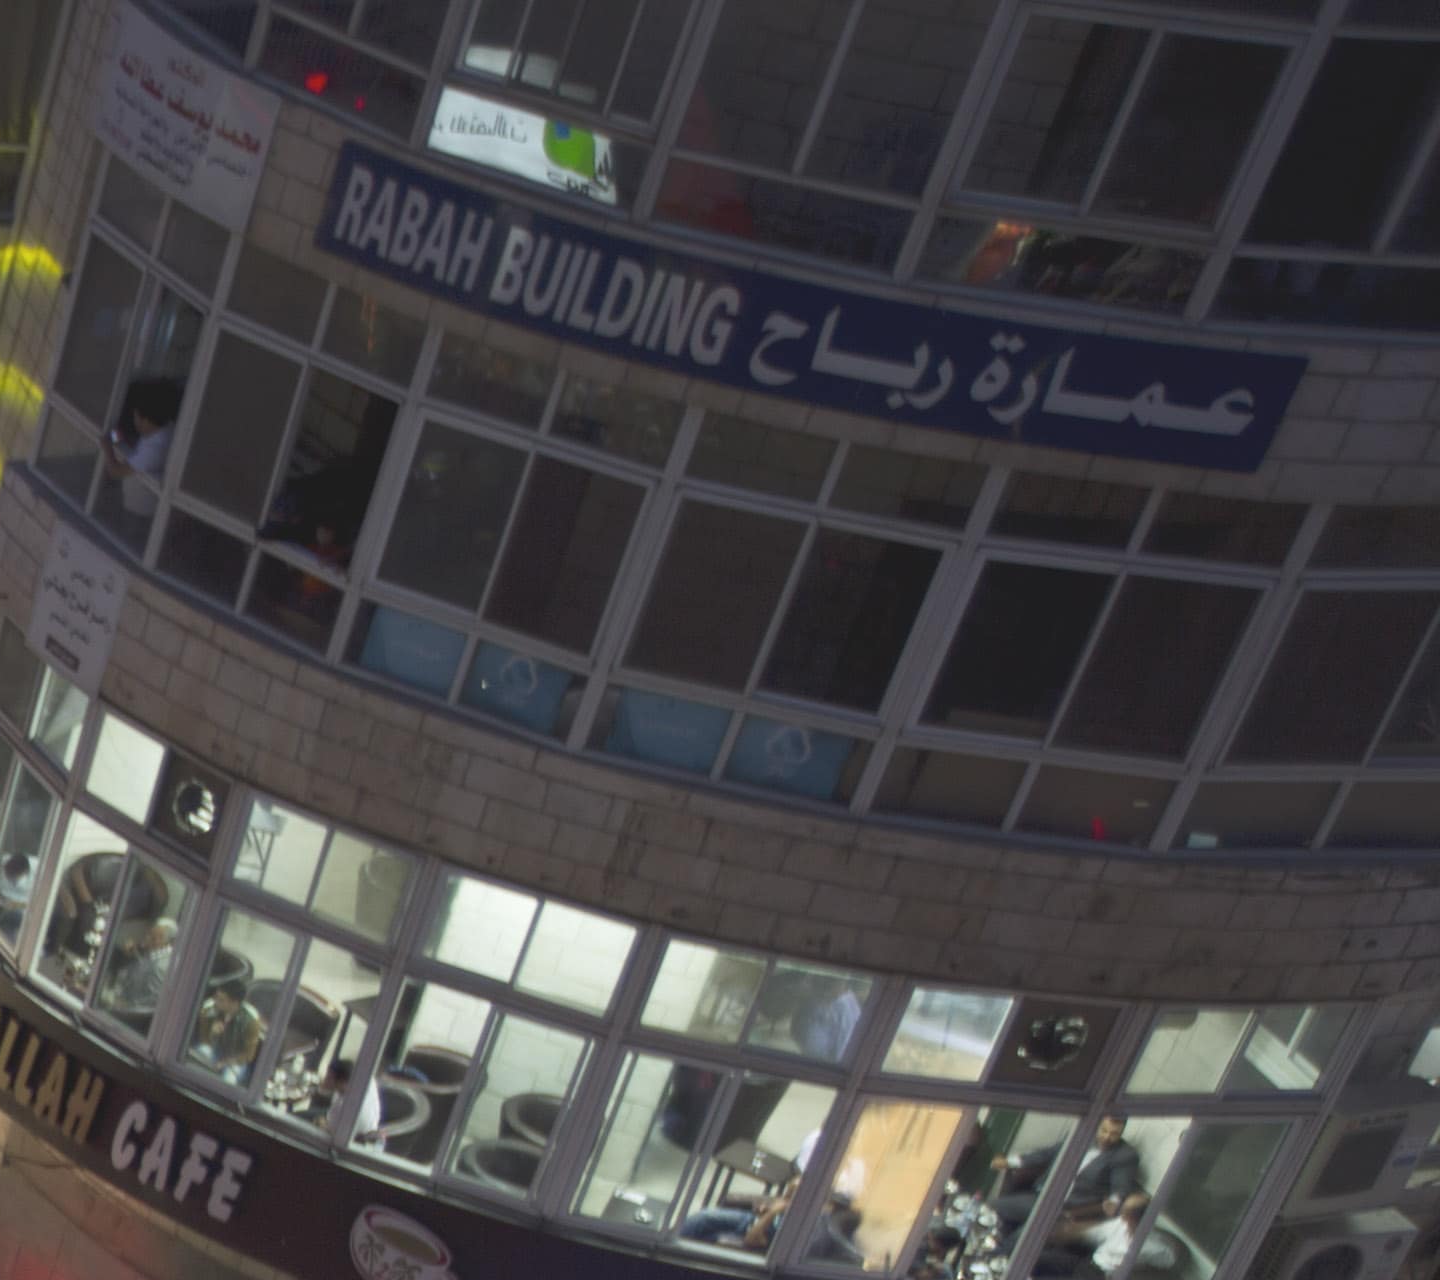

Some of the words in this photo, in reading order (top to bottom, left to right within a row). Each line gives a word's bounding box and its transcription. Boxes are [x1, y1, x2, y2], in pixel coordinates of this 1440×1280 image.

[334, 163, 493, 293] RABAH
[489, 225, 742, 367] BUILDING
[750, 303, 954, 410] رباح
[970, 331, 1255, 436] عمارة
[108, 1098, 253, 1225] CAFE
